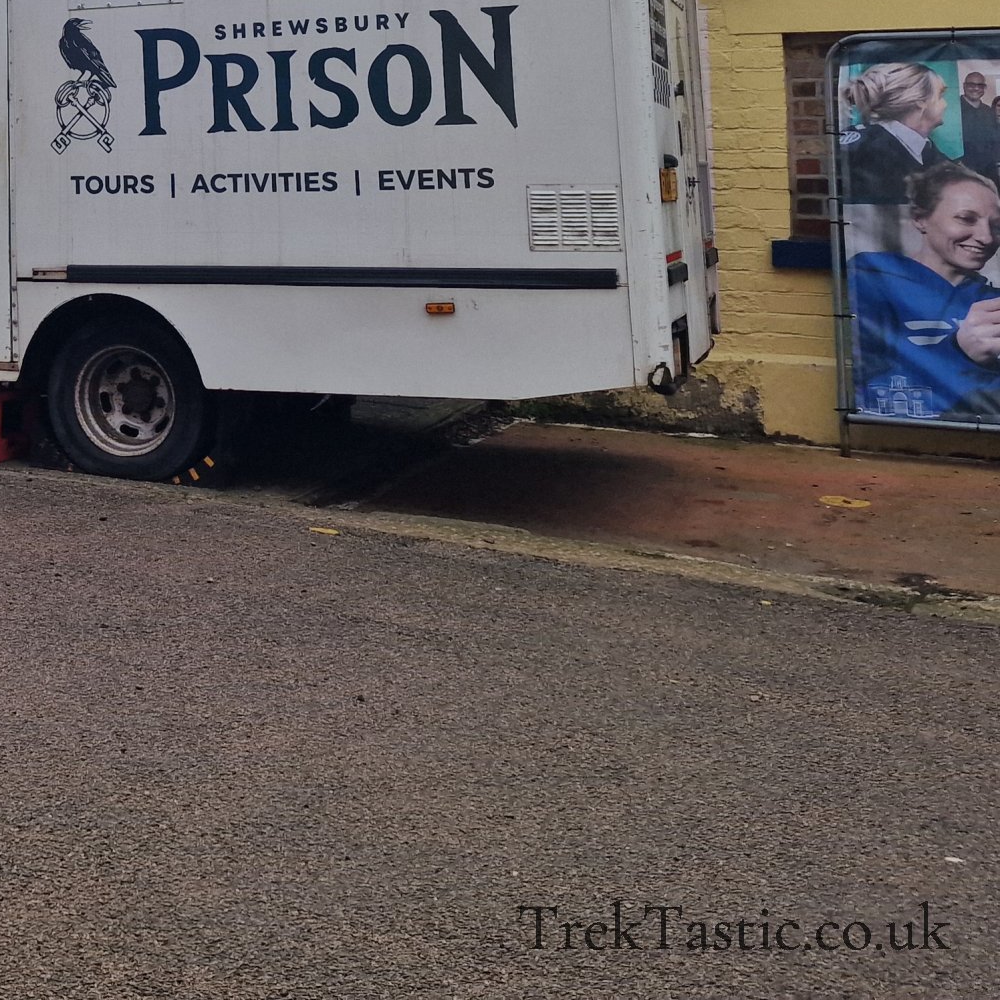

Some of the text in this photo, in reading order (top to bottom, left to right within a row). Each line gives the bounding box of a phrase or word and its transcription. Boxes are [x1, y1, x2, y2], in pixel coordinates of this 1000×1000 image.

[214, 12, 410, 41] SHREWSBURY
[133, 4, 520, 137] PRISON
[71, 174, 155, 195] TOURS
[190, 171, 338, 194] ACTIVITIES
[378, 167, 495, 191] EVENTS
